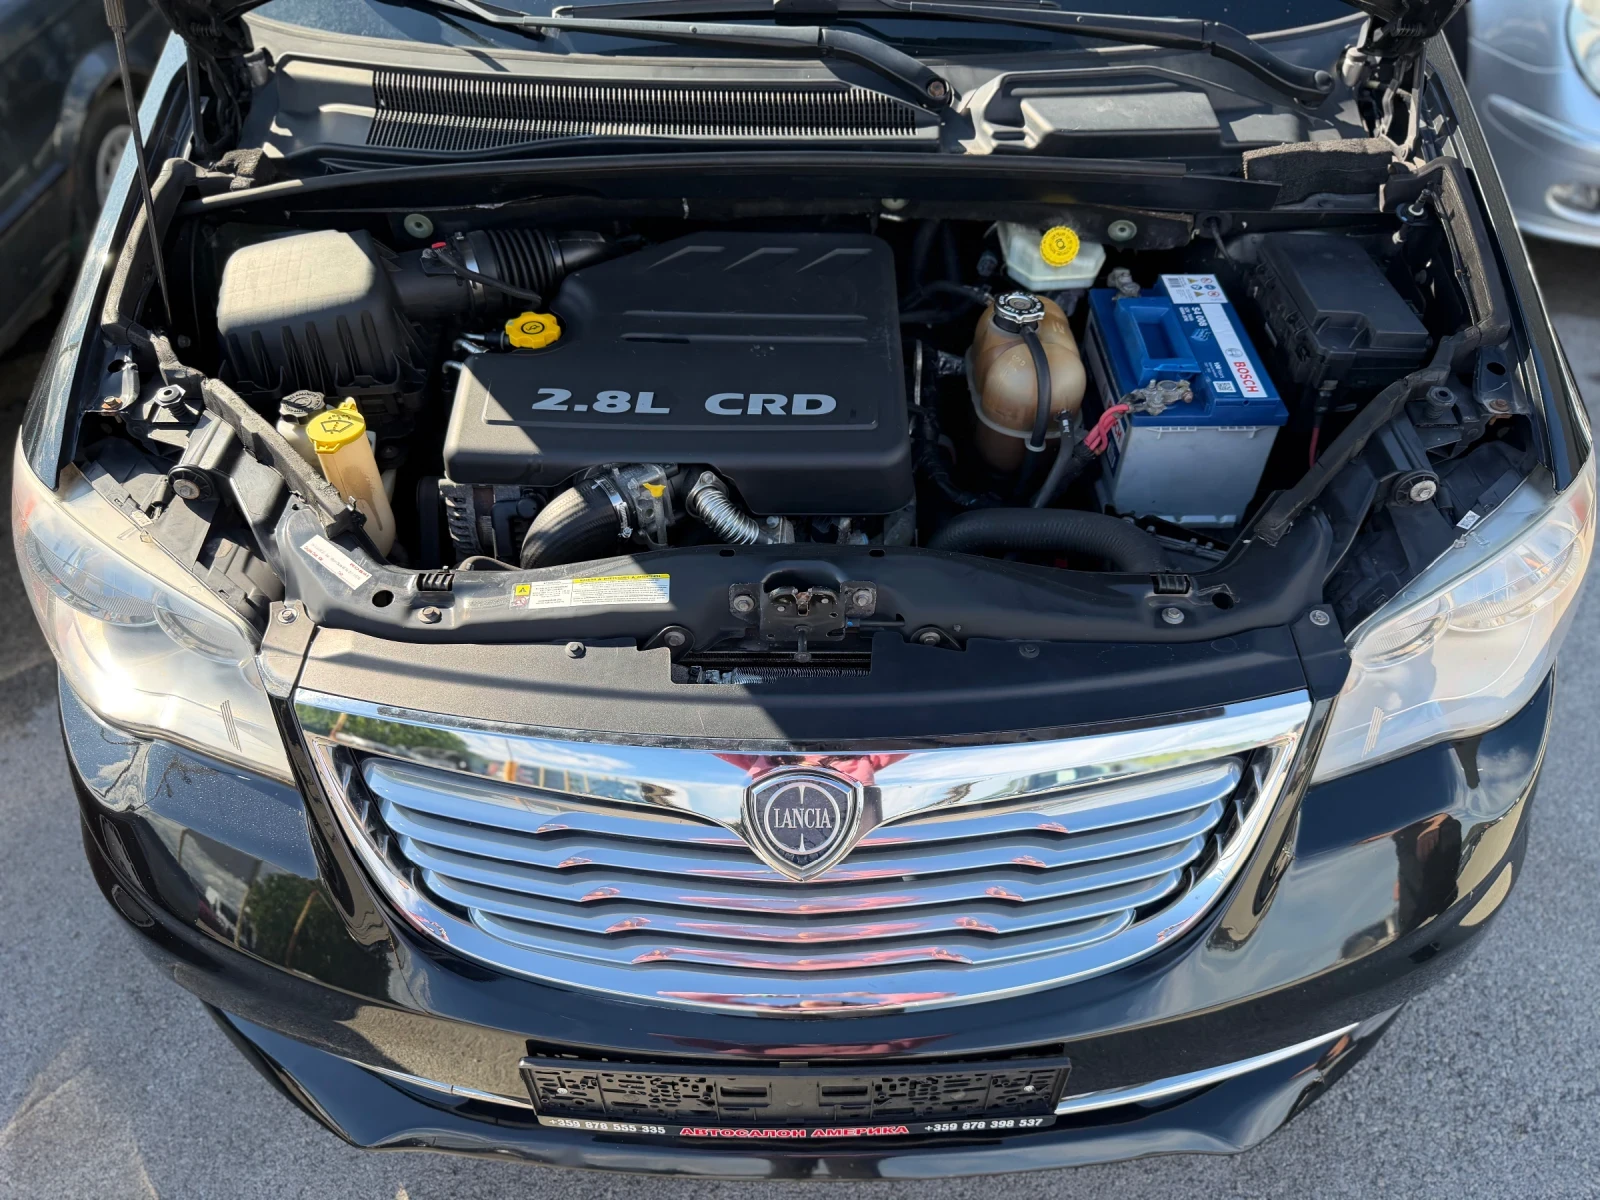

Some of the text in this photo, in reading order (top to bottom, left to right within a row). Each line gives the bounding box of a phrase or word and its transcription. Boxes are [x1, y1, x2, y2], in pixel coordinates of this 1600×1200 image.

[1233, 361, 1259, 393] BOSCH
[531, 388, 837, 415] 2.8L CRD
[773, 808, 832, 829] LANCIA
[549, 1119, 666, 1134] +359 878 555 335
[679, 1125, 910, 1138] АВТОСАЛОН АМЕРИКА
[924, 1118, 1043, 1133] +359 878 398 537
